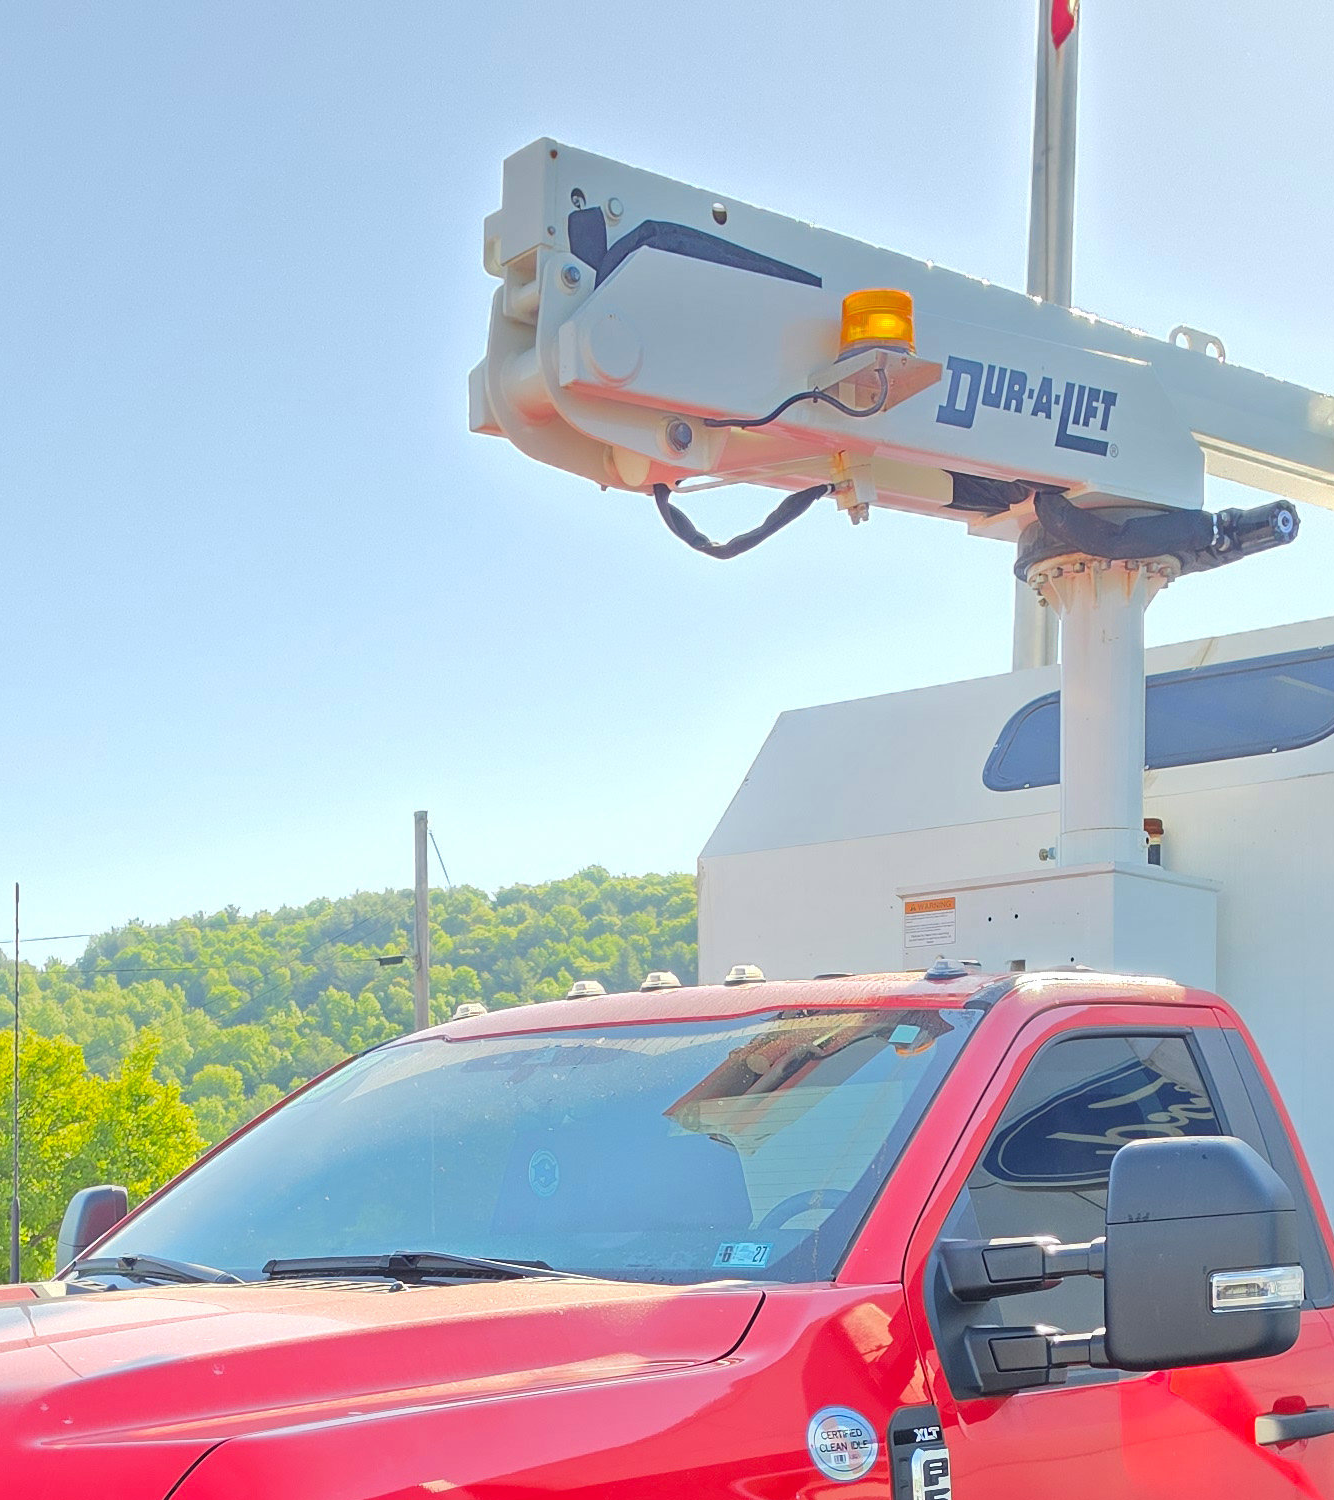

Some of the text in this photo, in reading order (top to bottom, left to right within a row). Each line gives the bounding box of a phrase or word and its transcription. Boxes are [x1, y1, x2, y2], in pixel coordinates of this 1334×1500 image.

[752, 1246, 768, 1262] 27
[820, 1428, 863, 1440] CERTIFIED
[913, 1426, 940, 1442] XLT
[819, 1440, 870, 1453] CLEAN IDLE
